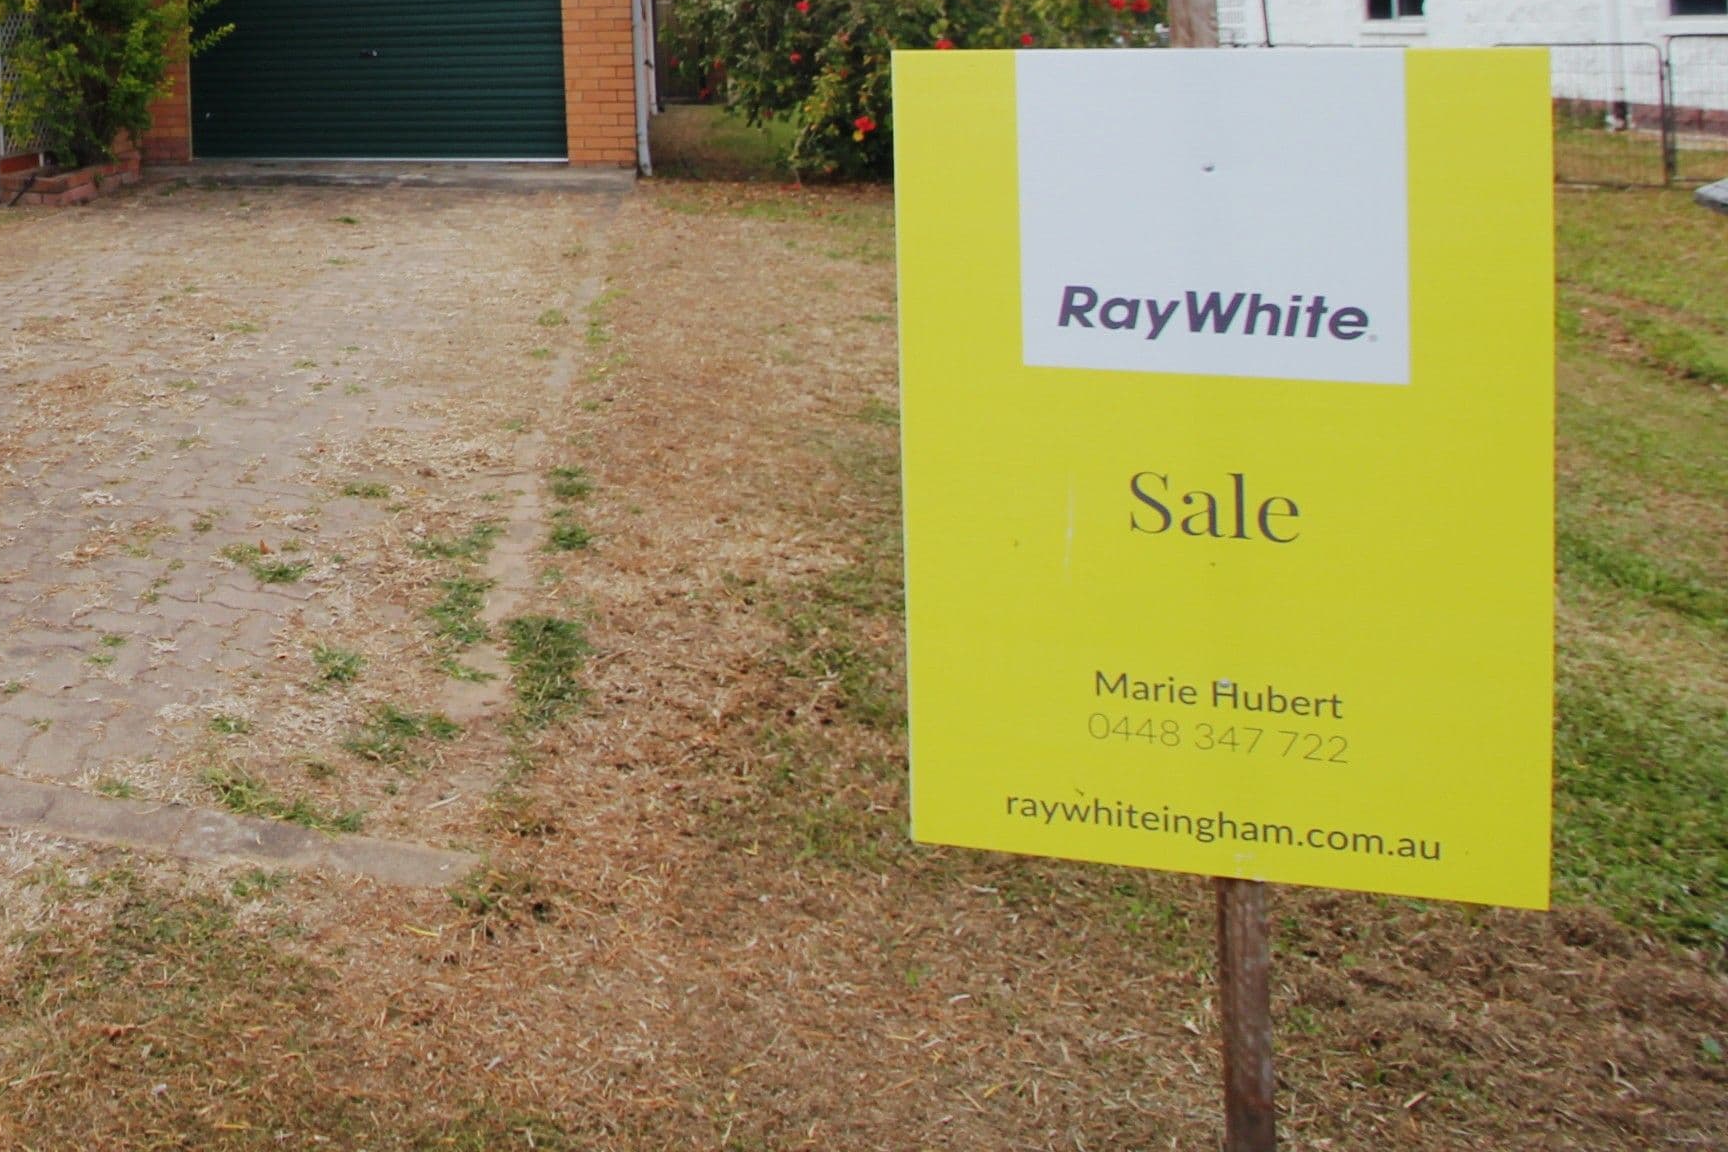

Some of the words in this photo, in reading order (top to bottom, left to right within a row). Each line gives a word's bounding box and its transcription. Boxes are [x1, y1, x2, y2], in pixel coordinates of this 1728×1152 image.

[1131, 472, 1300, 543] Sale
[1095, 672, 1197, 704] Marie
[1212, 681, 1344, 719] Hubert
[1088, 714, 1181, 747] 0448
[1195, 724, 1263, 754] 347
[1279, 732, 1349, 764] 722
[1007, 795, 1440, 861] raywhiteingham.com.au
